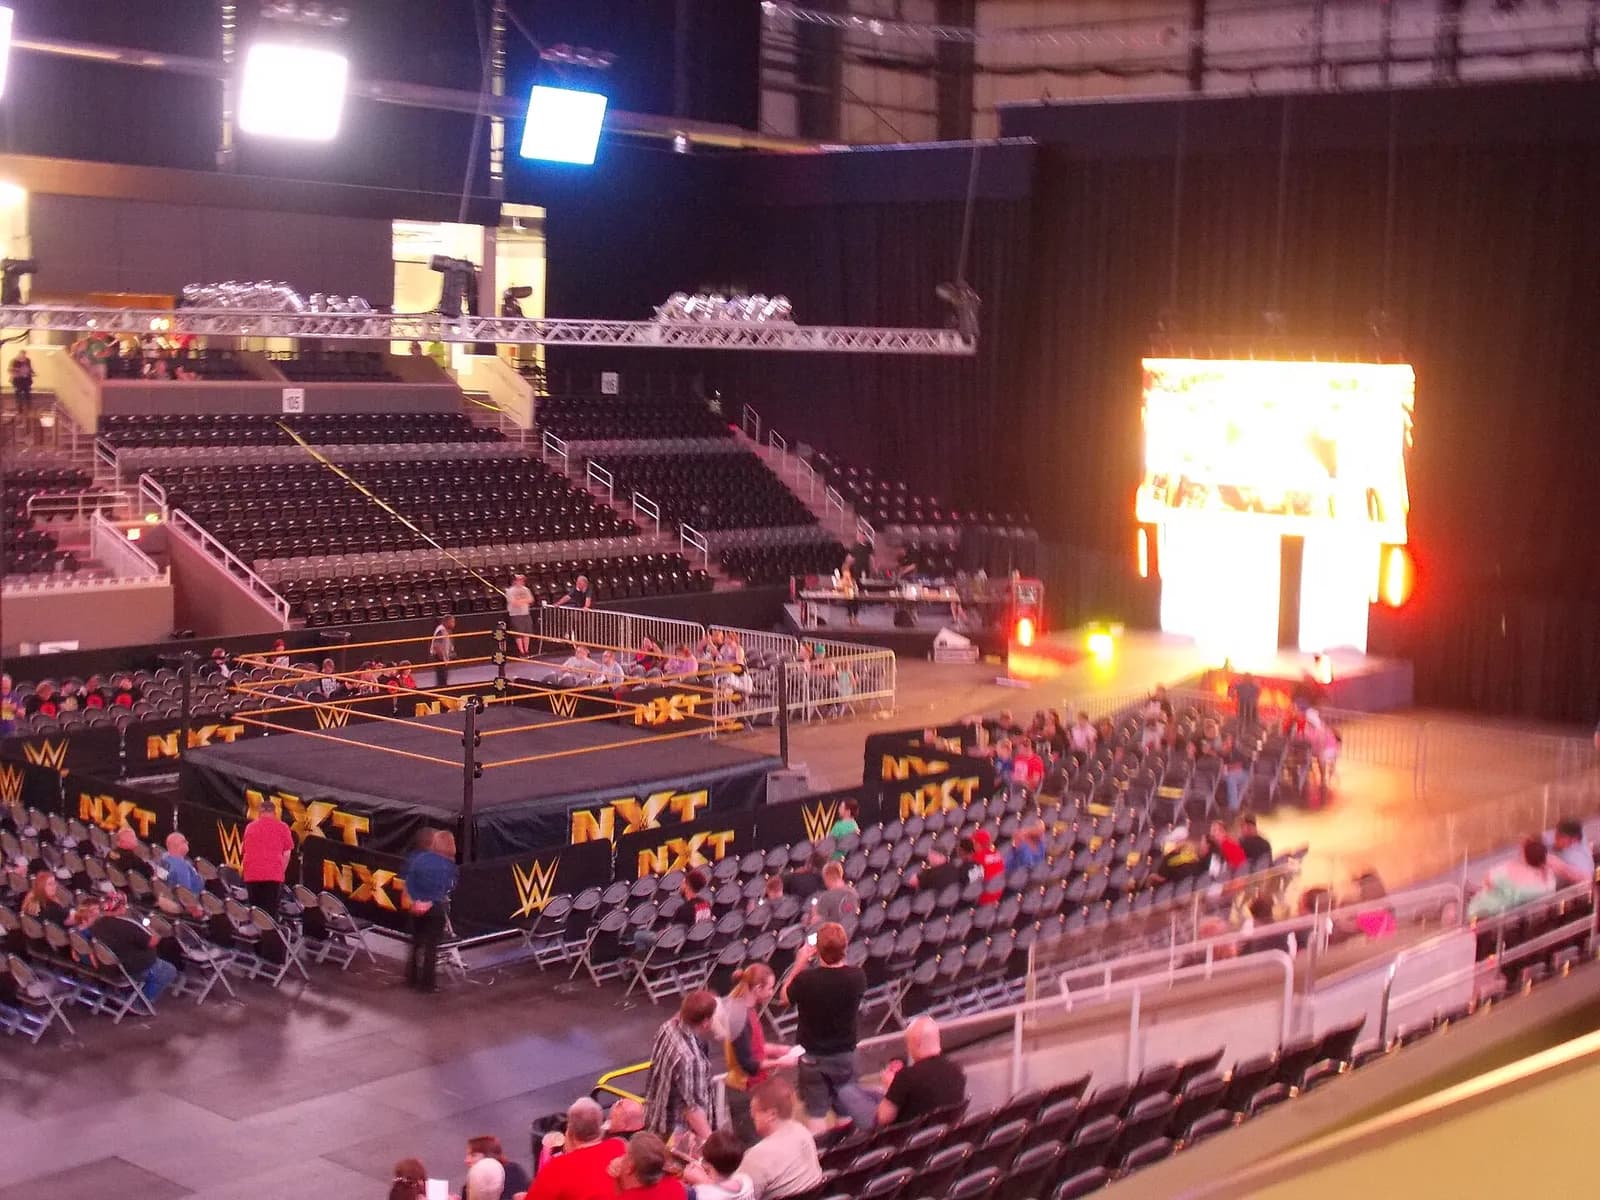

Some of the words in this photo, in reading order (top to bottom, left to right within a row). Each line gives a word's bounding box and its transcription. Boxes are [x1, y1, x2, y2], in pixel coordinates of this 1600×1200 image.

[634, 694, 701, 726] NXT
[79, 793, 157, 838] NXT
[246, 789, 370, 847] NXT
[571, 790, 708, 851] NXT
[900, 776, 980, 818] NXT
[637, 830, 735, 880] NXT
